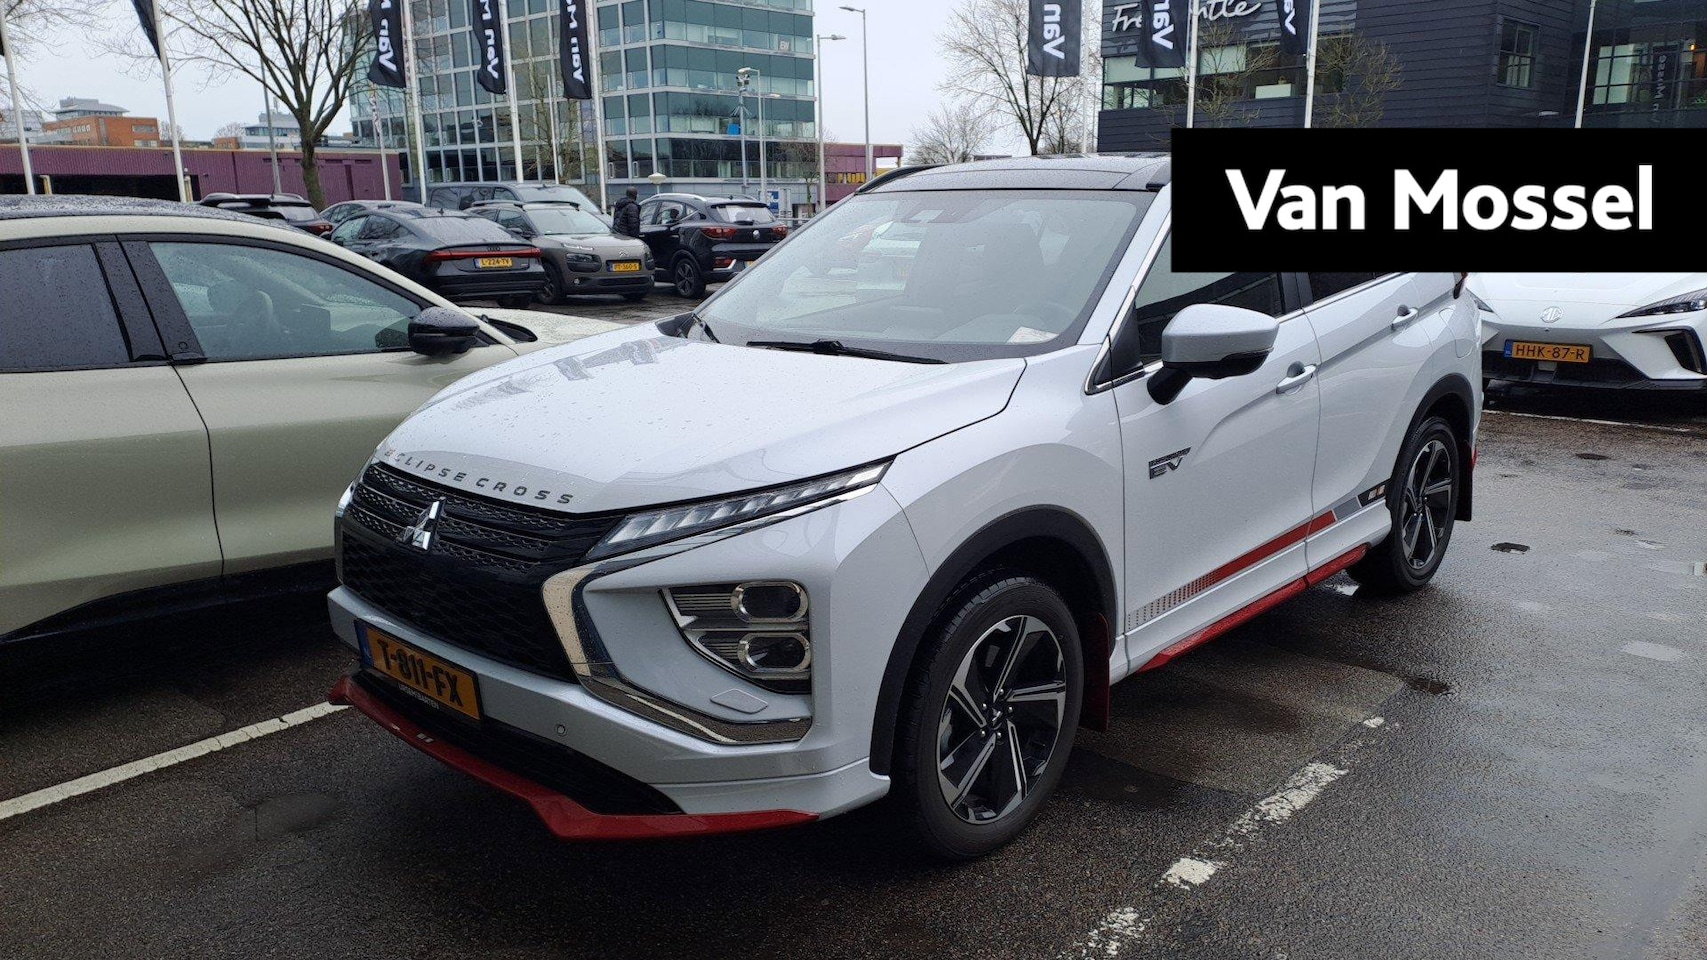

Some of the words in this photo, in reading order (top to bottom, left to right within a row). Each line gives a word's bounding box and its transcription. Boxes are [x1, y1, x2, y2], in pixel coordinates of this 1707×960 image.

[1515, 344, 1585, 360] HHK-87-R
[385, 450, 467, 483] ECLIPSE
[476, 477, 574, 505] CROSS
